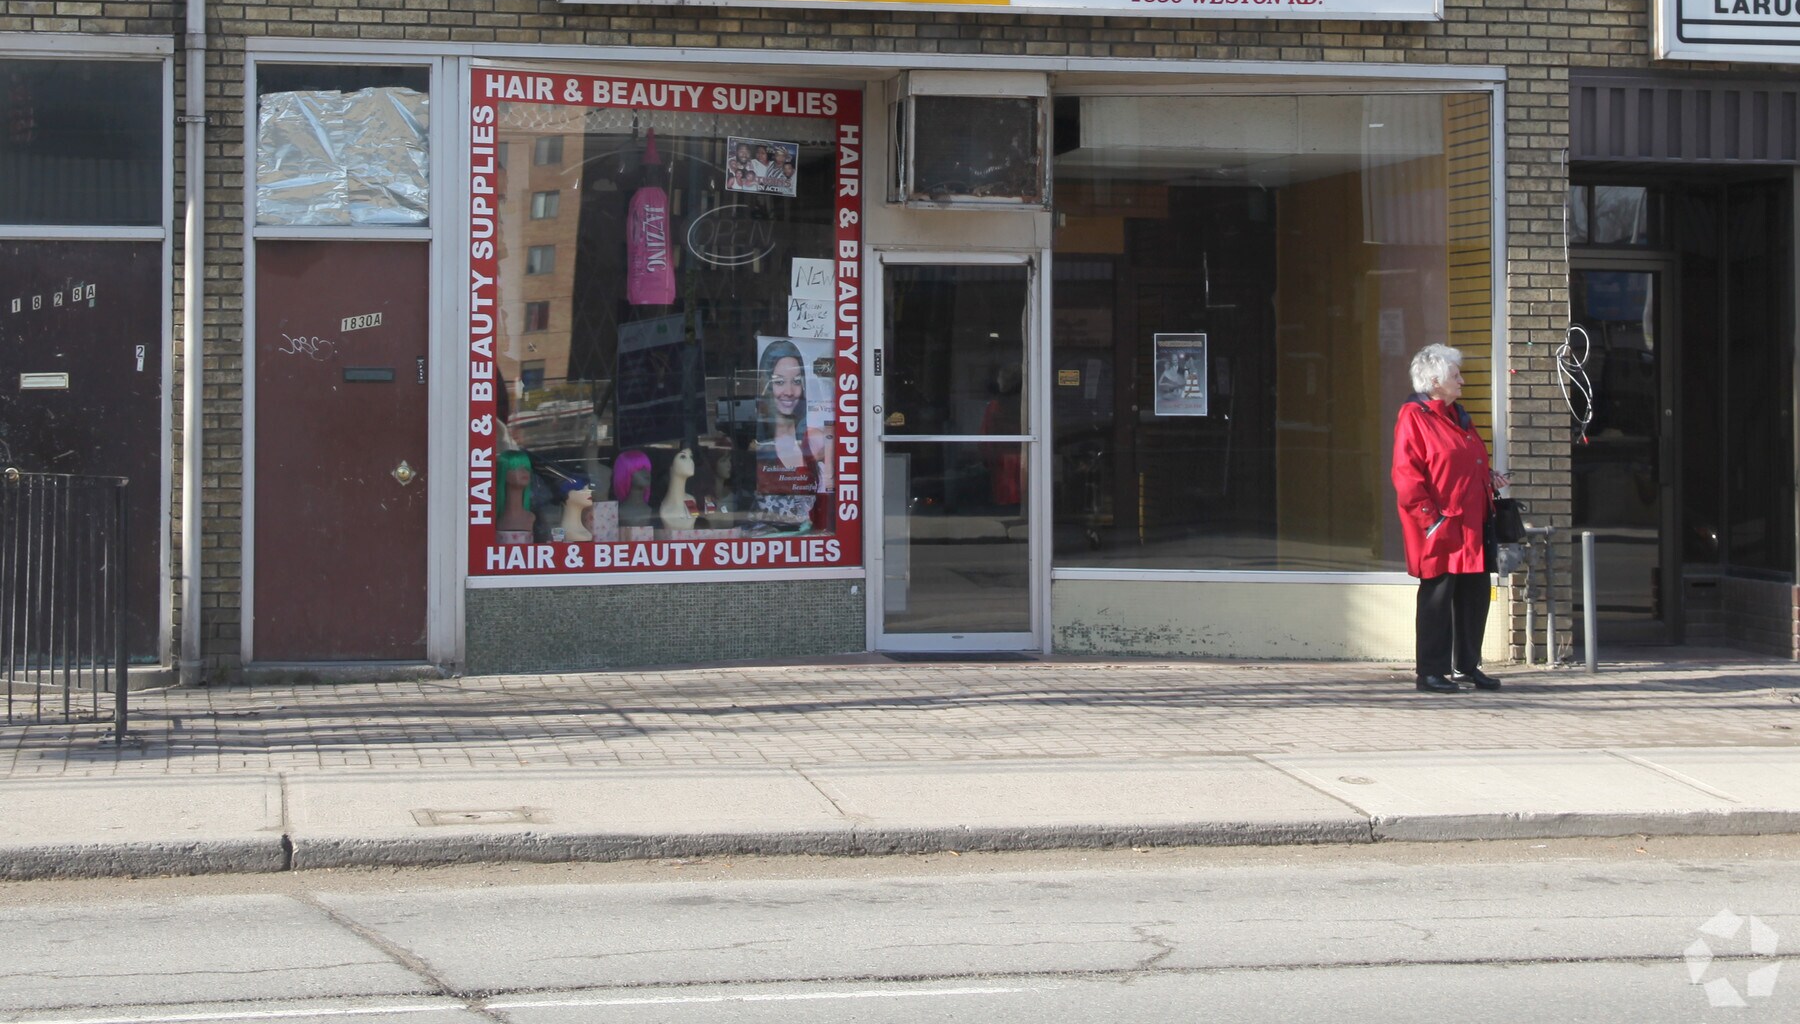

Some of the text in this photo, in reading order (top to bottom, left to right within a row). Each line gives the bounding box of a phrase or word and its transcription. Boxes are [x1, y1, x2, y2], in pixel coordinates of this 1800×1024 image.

[486, 74, 838, 116] HAIR & BEAUTY SUPPLIES
[643, 204, 667, 272] JAZZING
[343, 314, 381, 331] 1830A
[470, 105, 494, 524] HAIR & BEAUTY SUPPLIES
[838, 124, 859, 521] HAIR & BEAUTY SUPPLIES
[486, 539, 841, 570] HAIR & BEAUTY SUPPLIES
